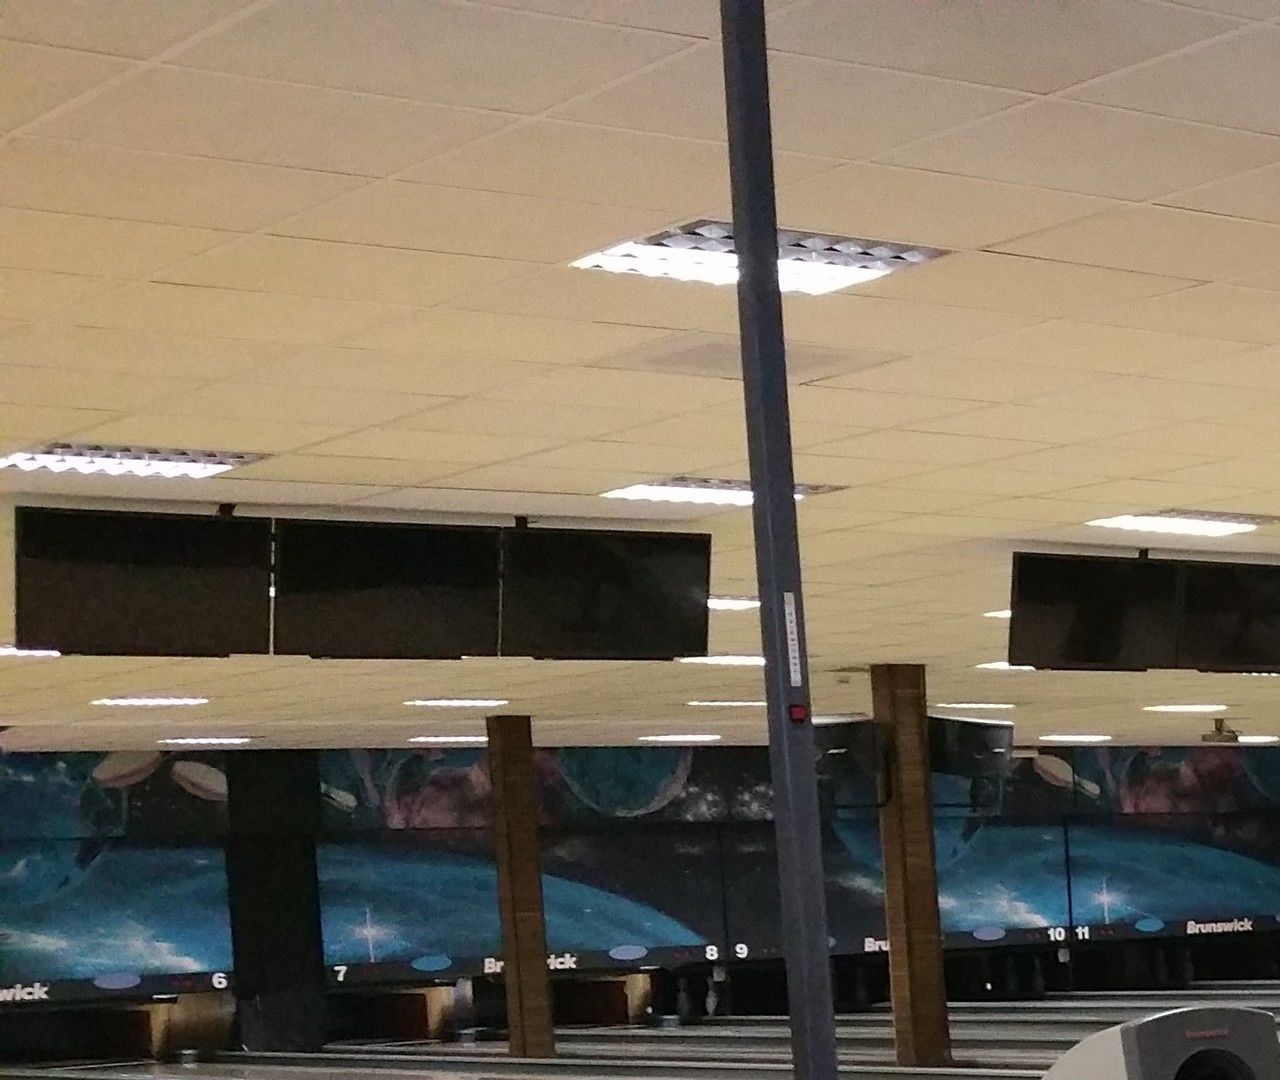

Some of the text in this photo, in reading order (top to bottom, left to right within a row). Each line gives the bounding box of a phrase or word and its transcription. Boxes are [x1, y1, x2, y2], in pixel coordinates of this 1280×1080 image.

[1075, 926, 1090, 940] 11
[1186, 916, 1253, 935] Brunswick
[1047, 928, 1066, 942] 10
[705, 944, 719, 960] 8
[735, 943, 749, 959] 9
[211, 972, 229, 989] 6
[333, 965, 348, 982] 7
